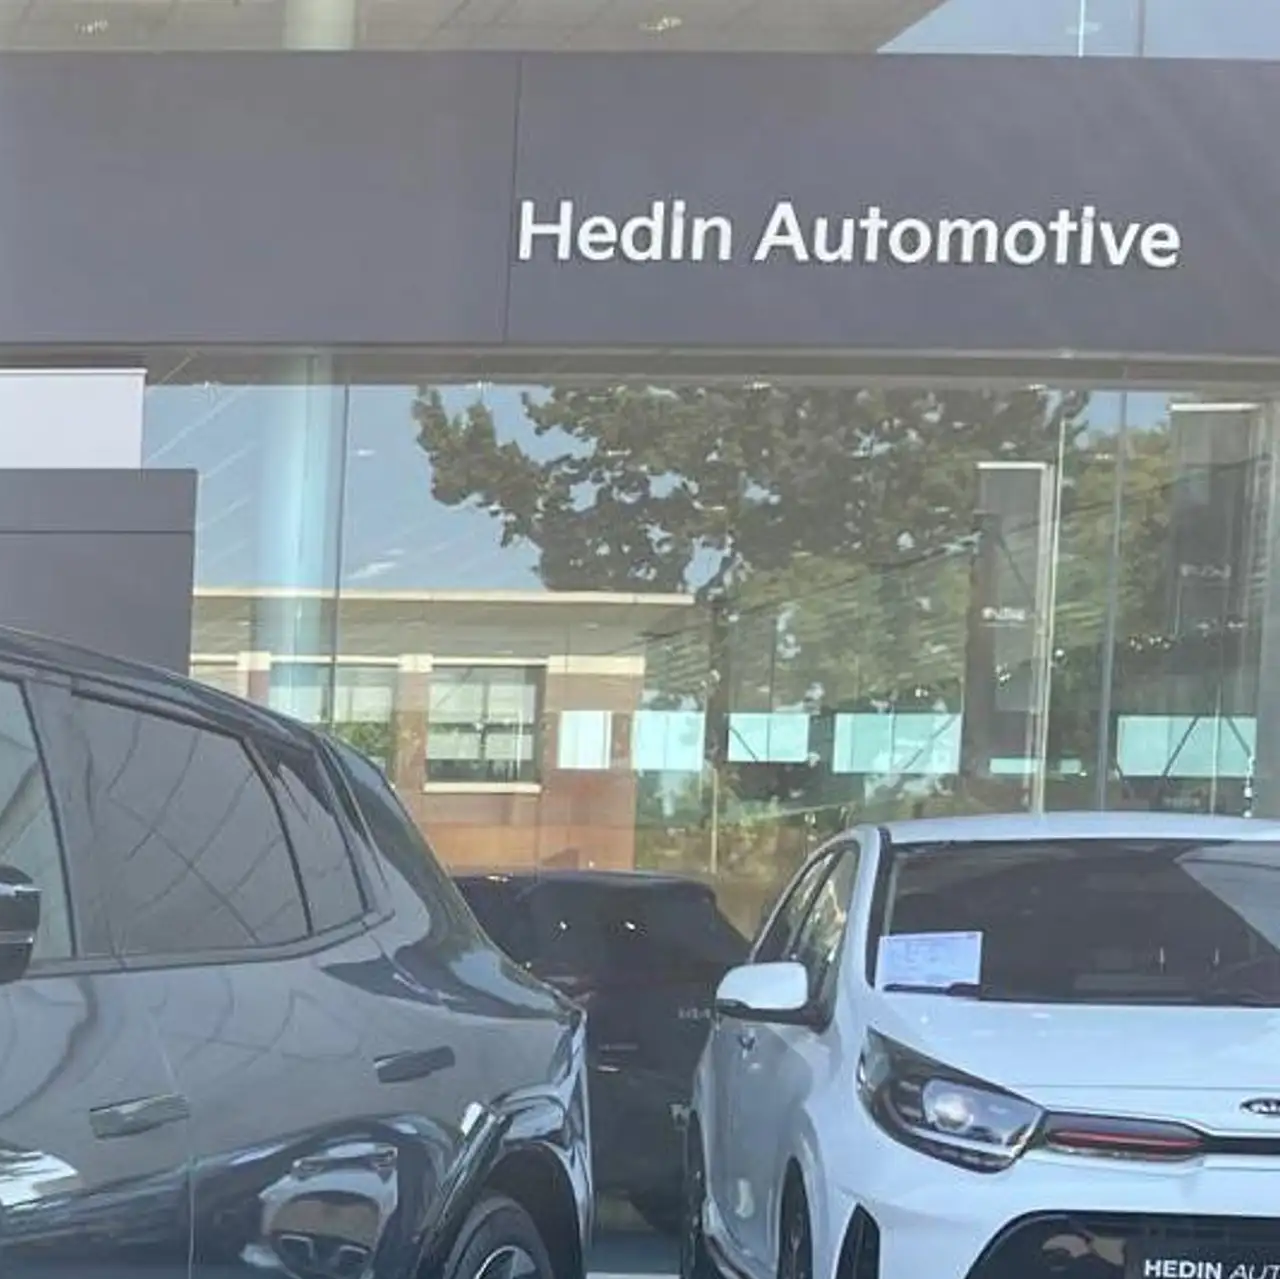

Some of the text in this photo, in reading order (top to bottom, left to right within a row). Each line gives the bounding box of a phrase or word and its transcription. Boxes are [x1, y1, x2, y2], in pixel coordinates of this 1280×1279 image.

[518, 199, 1182, 268] Hedin Automotive
[1144, 1259, 1222, 1279] HEDIN
